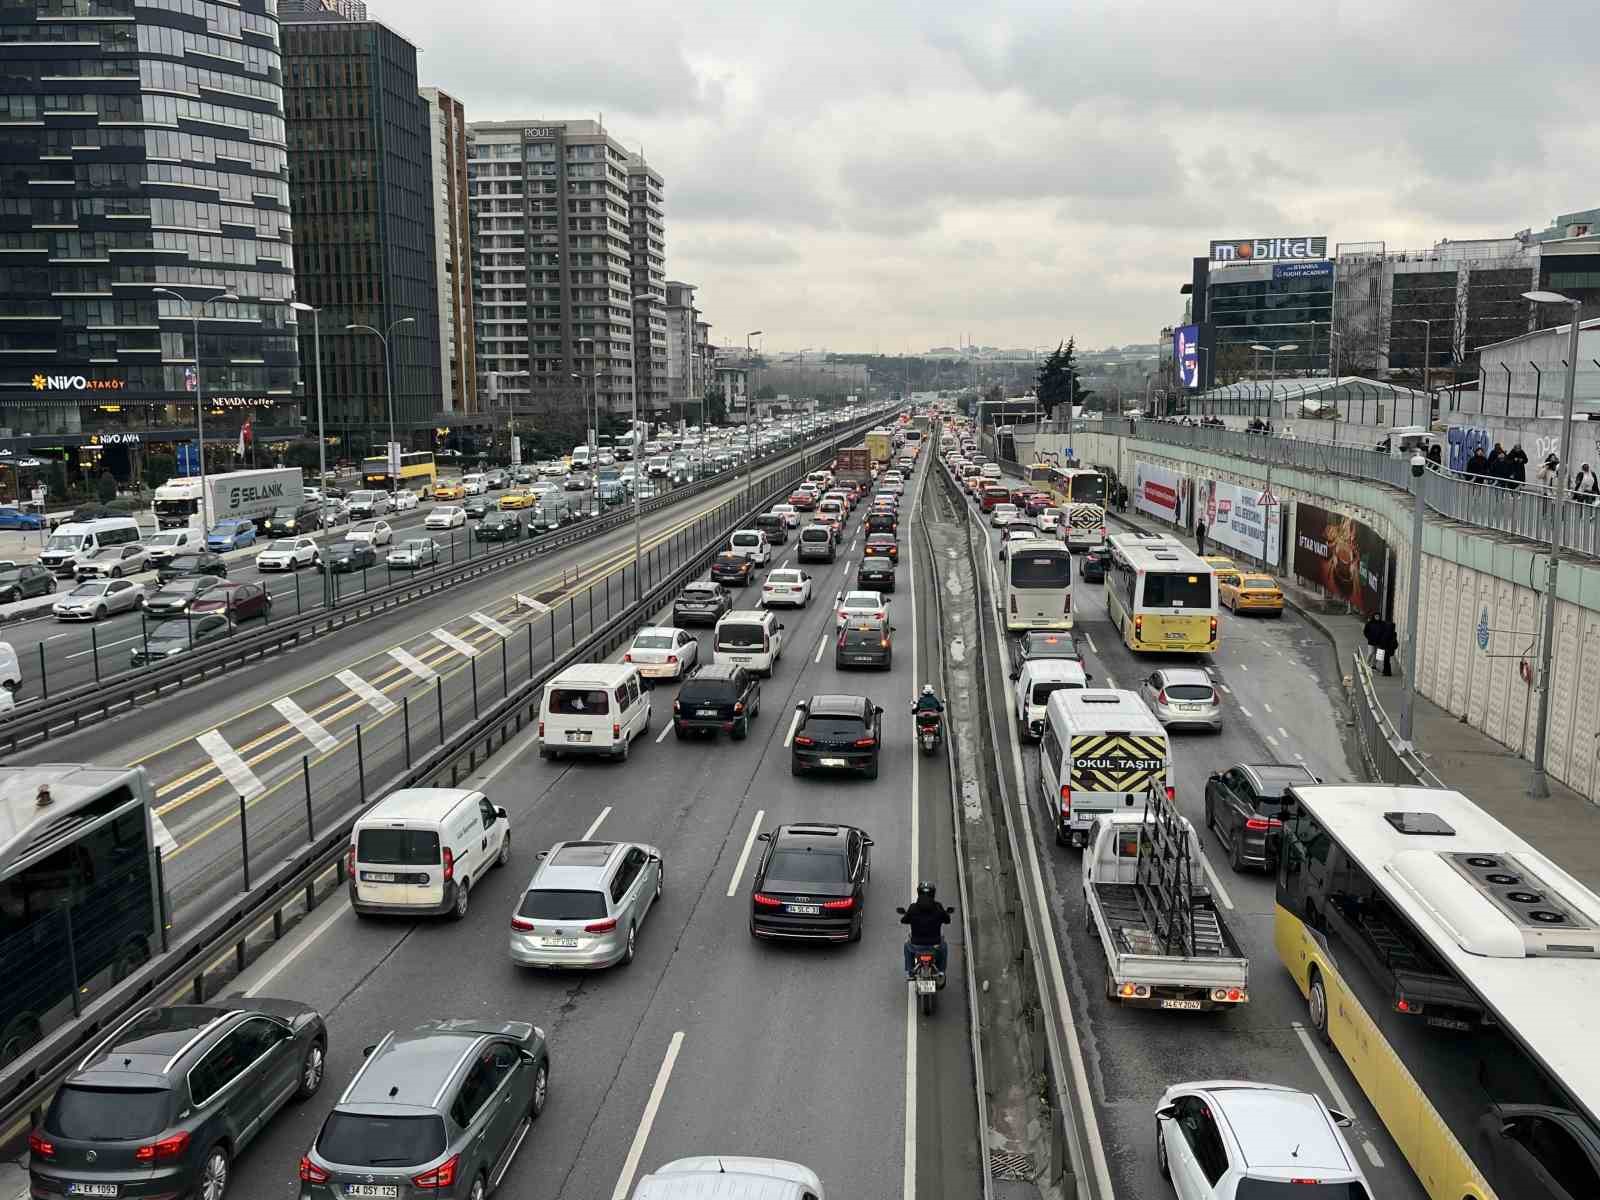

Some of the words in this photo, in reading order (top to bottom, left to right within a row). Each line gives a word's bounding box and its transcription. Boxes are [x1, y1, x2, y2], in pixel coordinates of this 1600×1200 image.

[212, 397, 247, 406] NEVADA
[248, 398, 274, 406] Coffee
[122, 433, 140, 443] AVM
[1076, 759, 1115, 769] OKUL
[1118, 760, 1160, 770] TAŞITI
[84, 1184, 93, 1193] EK
[97, 1185, 116, 1194] 1093
[351, 1185, 360, 1194] 34
[382, 1186, 396, 1196] 125
